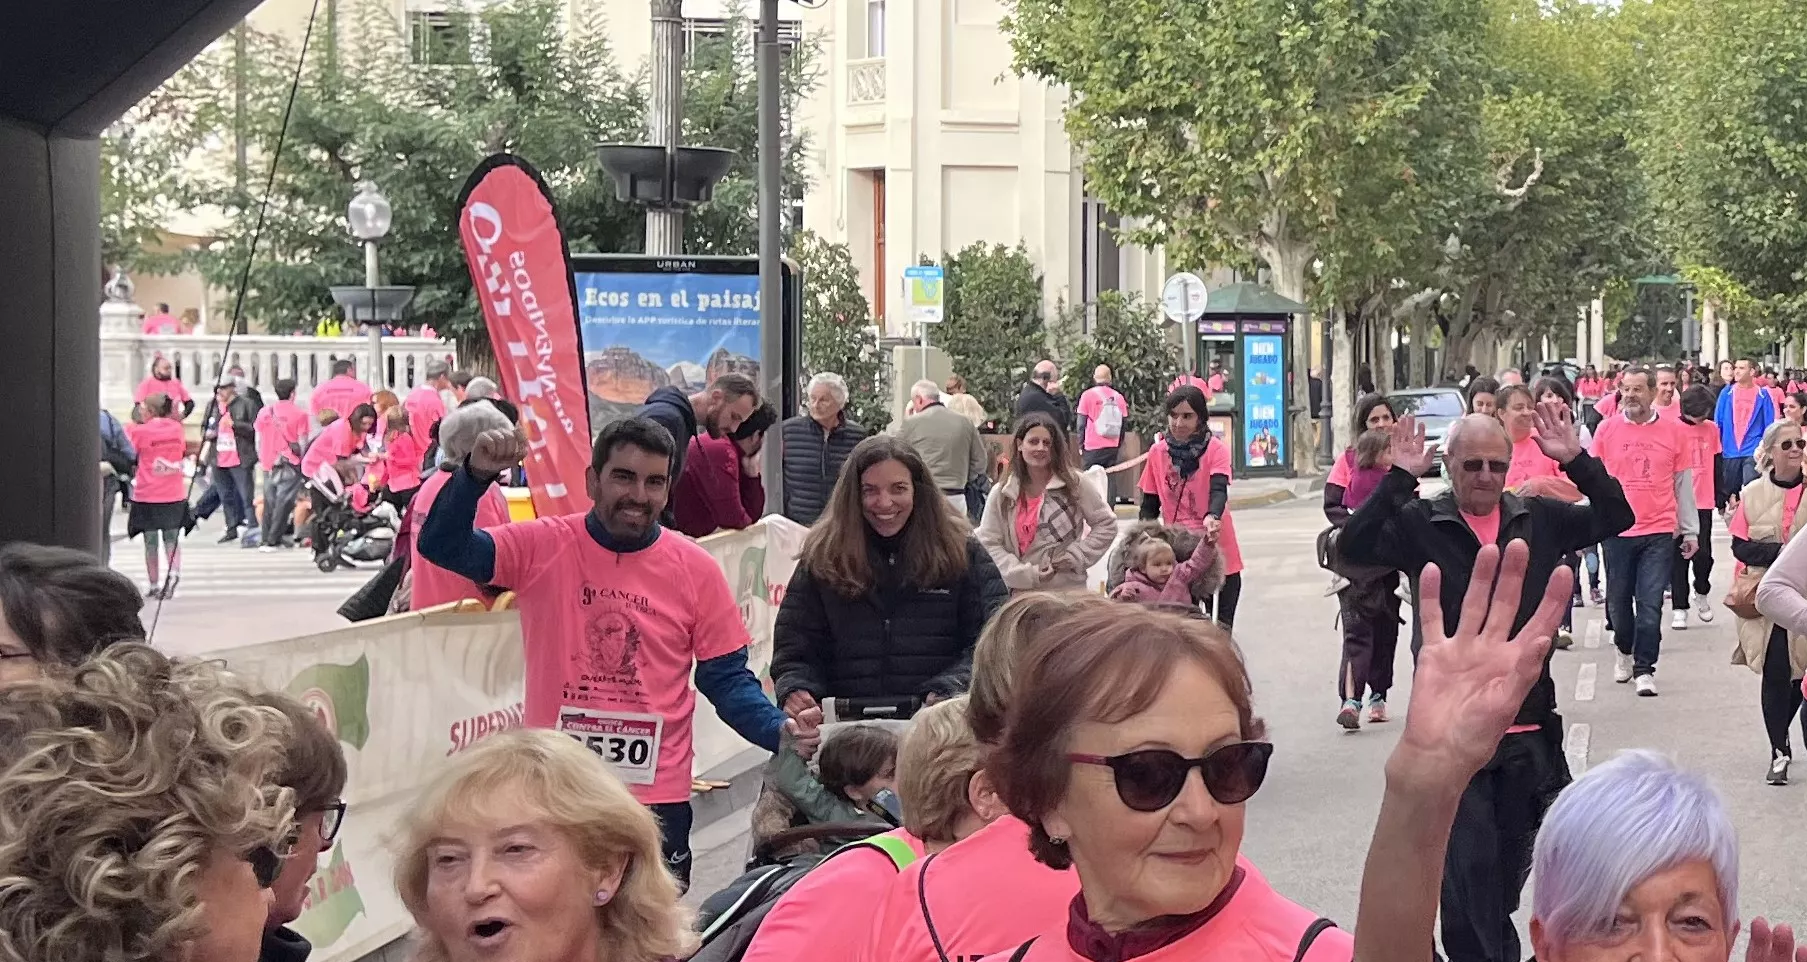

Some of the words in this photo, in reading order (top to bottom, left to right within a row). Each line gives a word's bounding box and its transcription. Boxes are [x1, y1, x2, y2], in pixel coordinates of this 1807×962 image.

[656, 261, 696, 269] URBAN
[585, 288, 629, 308] Ecos
[638, 292, 663, 308] en
[671, 289, 689, 308] el
[697, 289, 760, 311] paisaj
[709, 317, 732, 326] rutas
[734, 317, 760, 326] literar
[1252, 342, 1275, 355] BIEN
[1250, 355, 1278, 364] JUGADO
[1252, 405, 1275, 419] BIEN
[1250, 418, 1279, 429] JUGADO
[567, 721, 603, 732] CONTRA
[604, 725, 615, 733] EL
[616, 725, 651, 736] CÁNCER
[570, 734, 649, 766] 530
